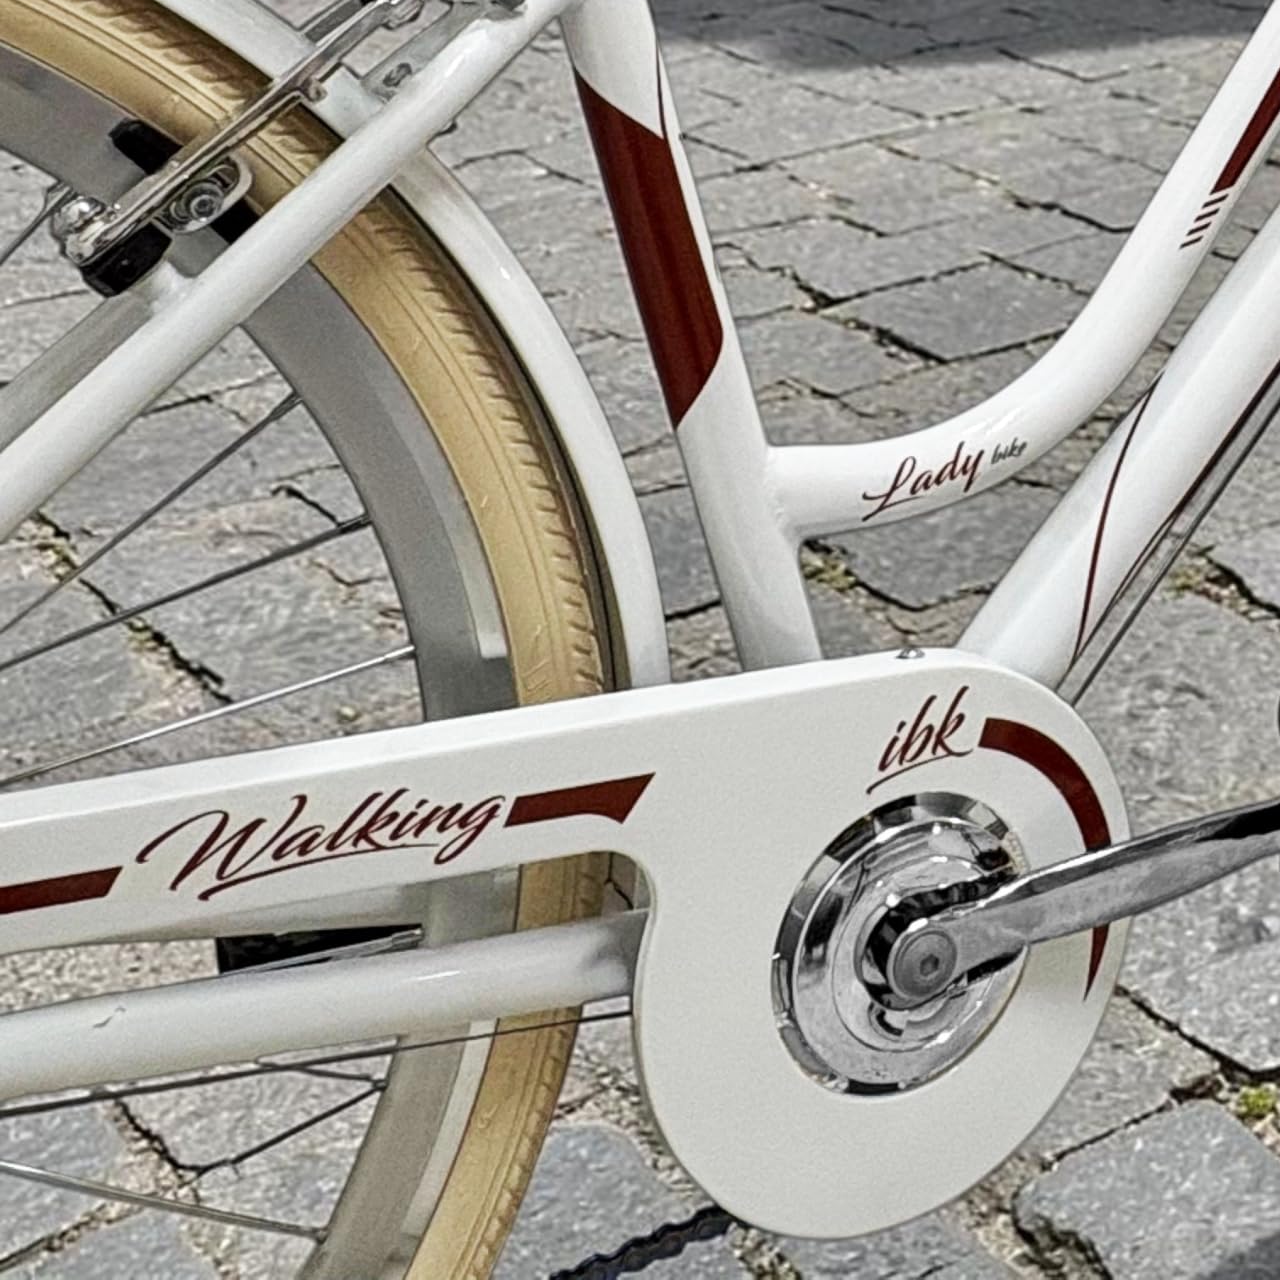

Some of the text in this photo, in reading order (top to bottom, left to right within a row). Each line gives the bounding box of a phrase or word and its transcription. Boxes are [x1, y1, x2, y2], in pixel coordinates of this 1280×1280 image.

[862, 437, 1027, 522] Lady bike
[866, 685, 975, 795] ibk
[135, 787, 506, 901] Walking
